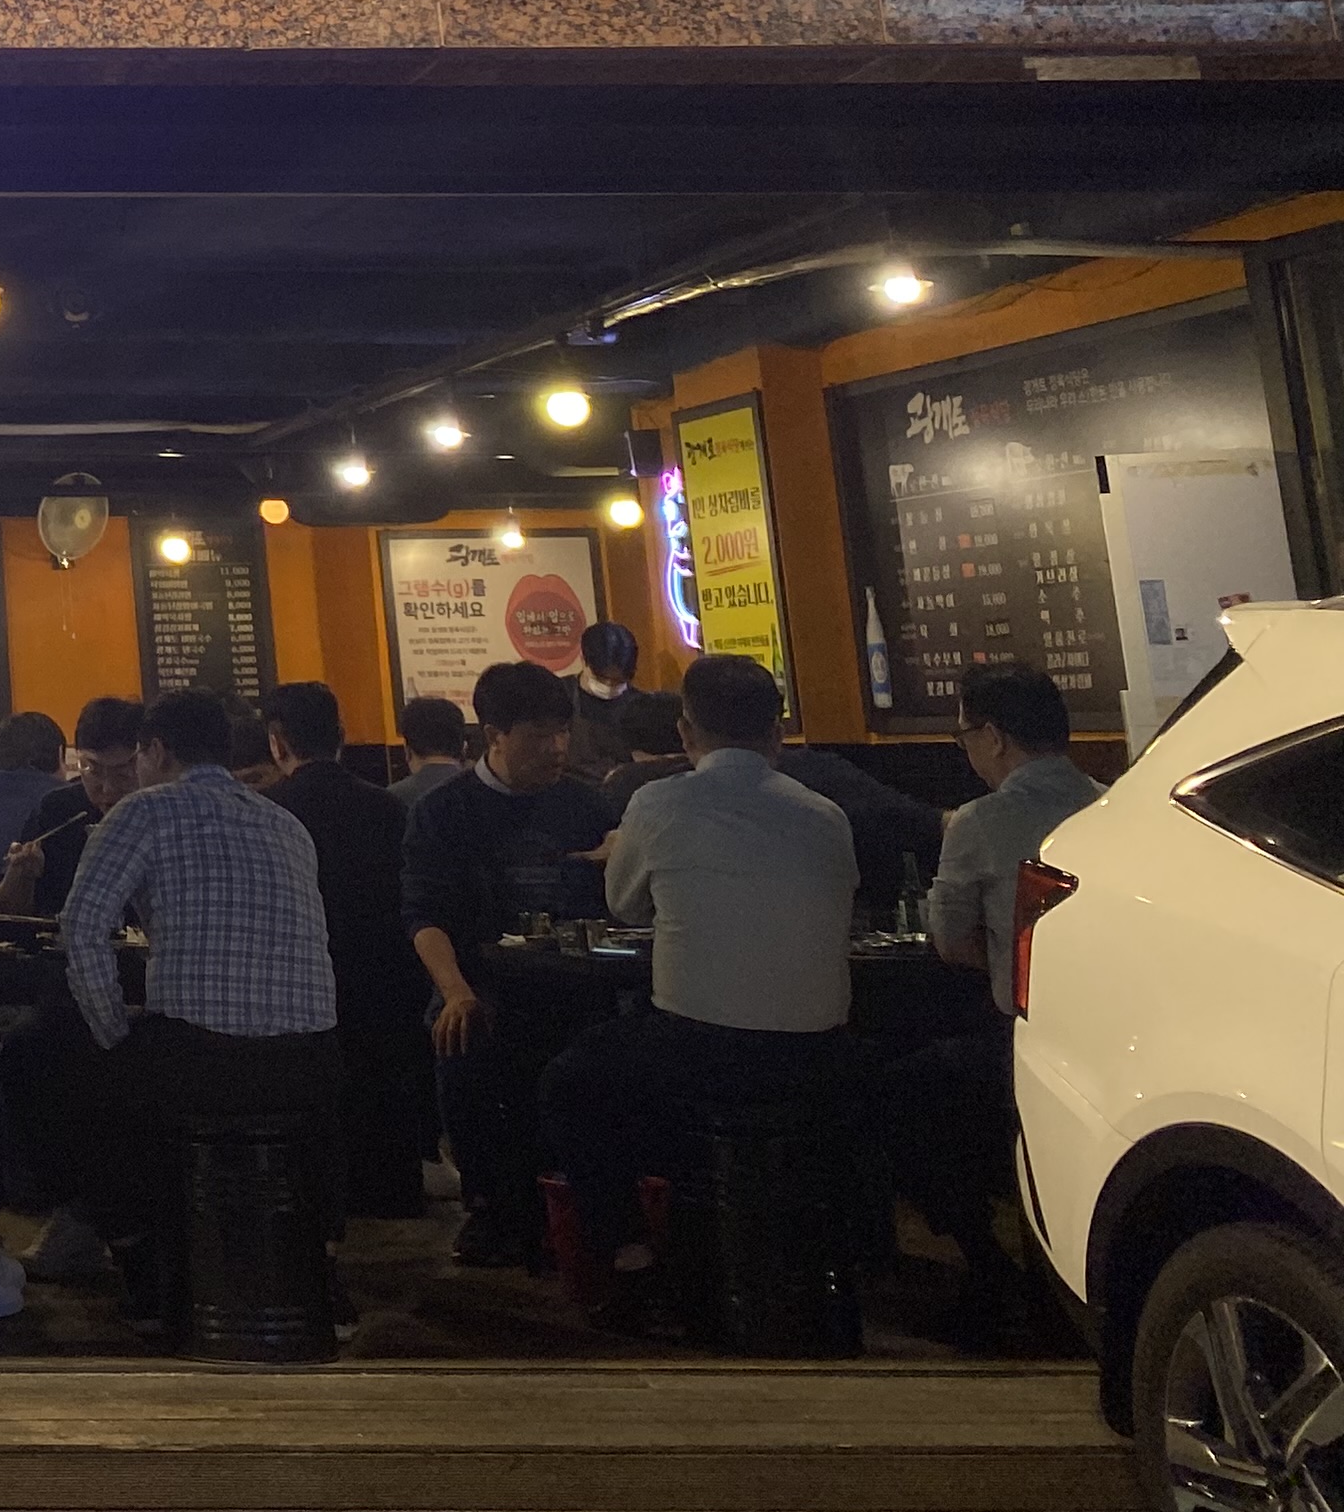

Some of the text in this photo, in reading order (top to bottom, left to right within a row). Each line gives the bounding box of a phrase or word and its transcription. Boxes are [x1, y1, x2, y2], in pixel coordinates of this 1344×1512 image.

[906, 392, 970, 444] 광개토
[708, 487, 761, 517] 상차림비를
[702, 527, 760, 565] 2,000원
[398, 579, 487, 598] 그램수(g)를
[702, 581, 774, 611] 받고 있습니다.
[403, 602, 486, 620] 확인하세요
